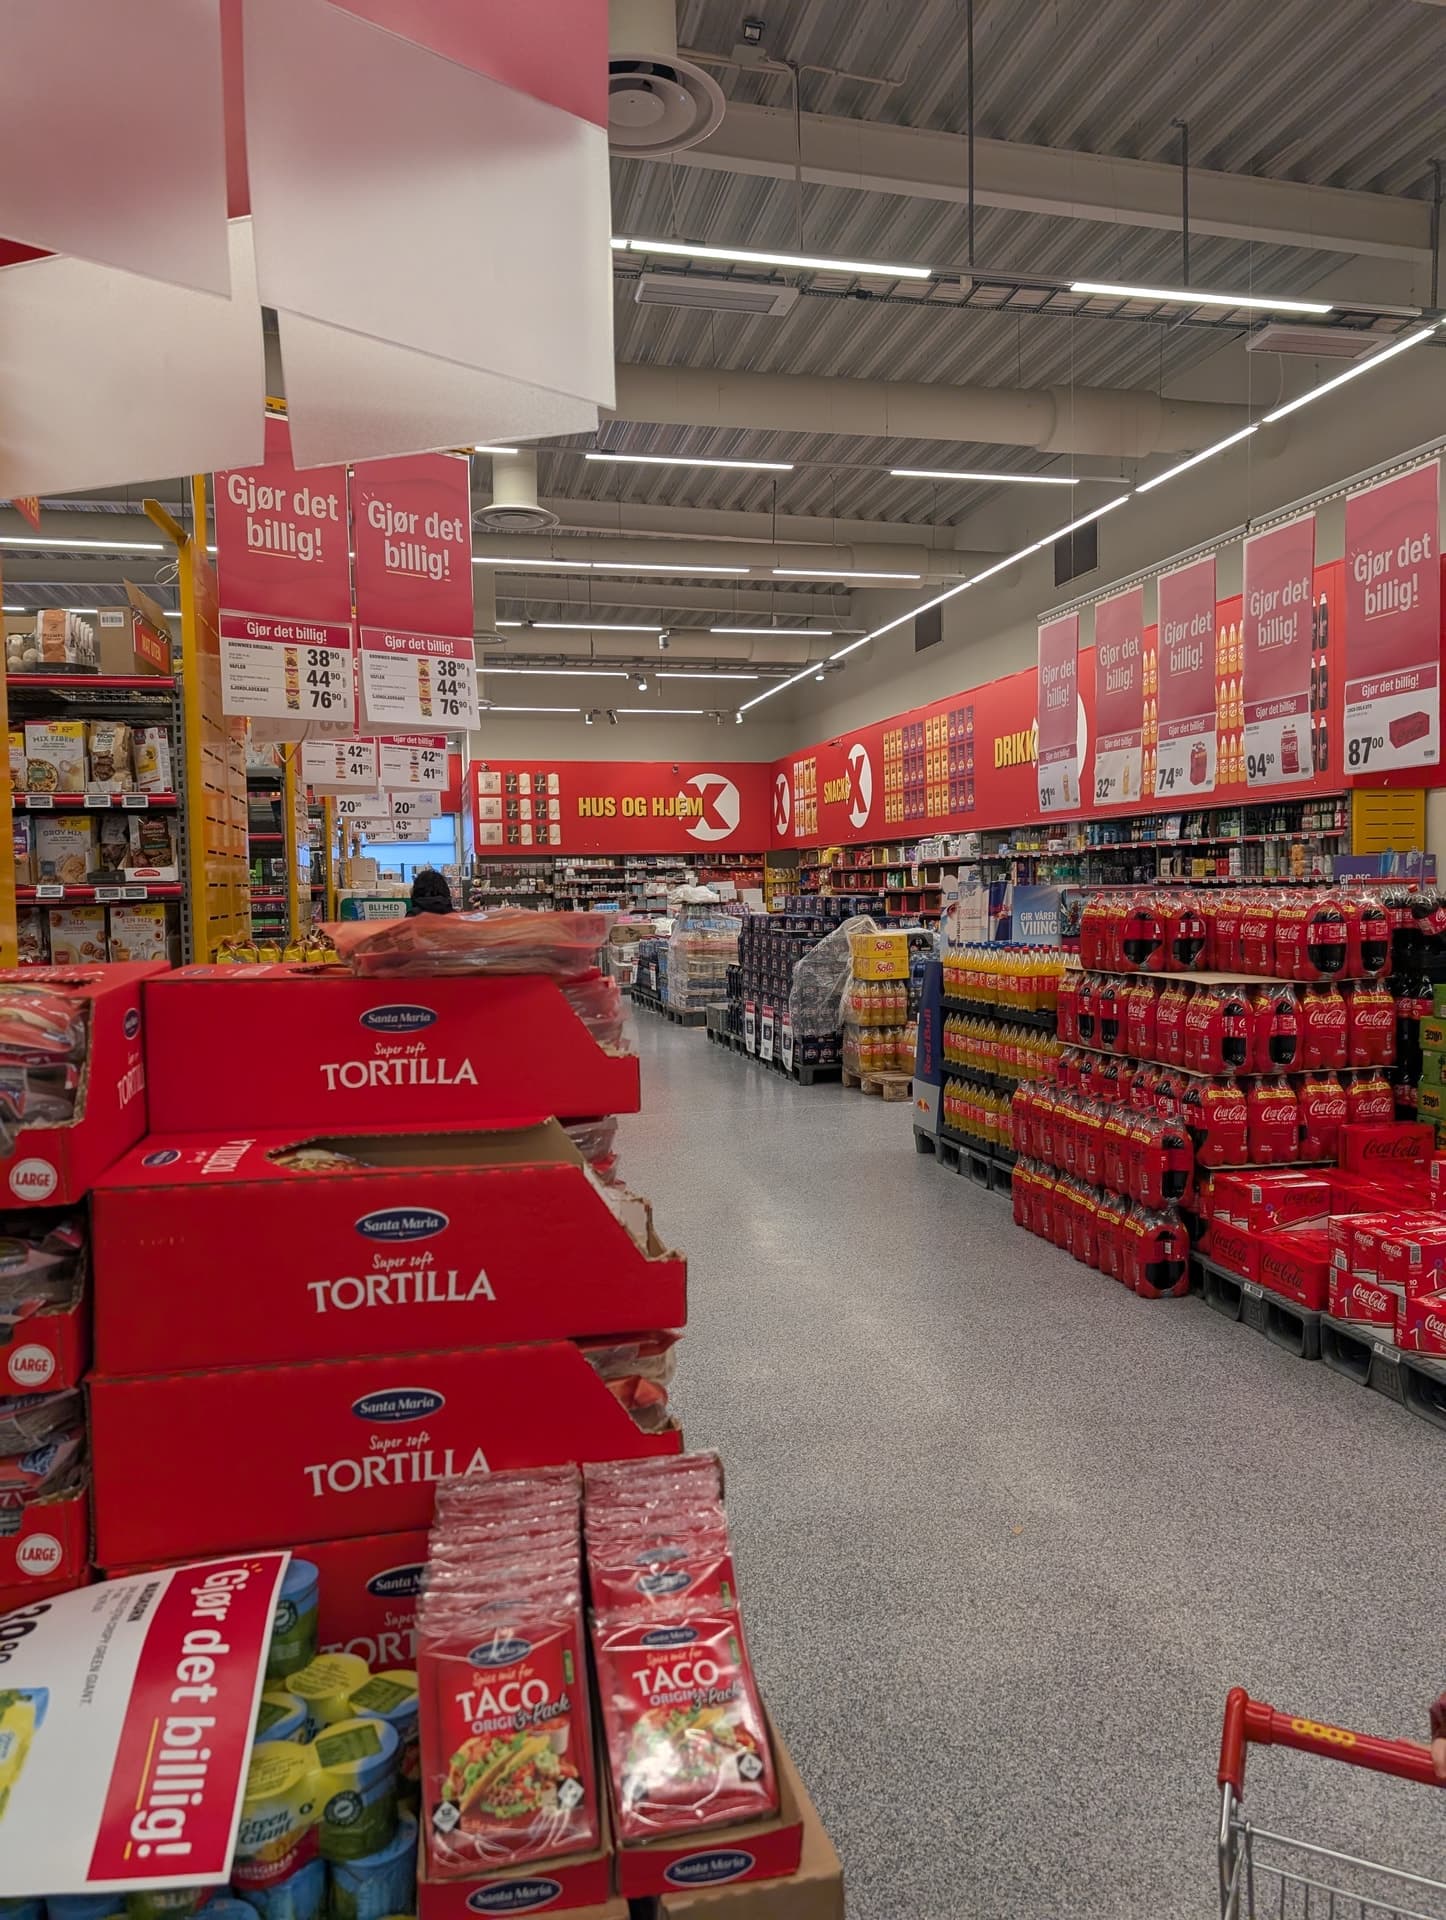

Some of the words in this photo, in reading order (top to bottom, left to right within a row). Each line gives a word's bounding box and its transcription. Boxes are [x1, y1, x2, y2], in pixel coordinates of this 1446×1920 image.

[228, 474, 286, 513] Gjør
[293, 487, 338, 521] det
[368, 500, 418, 536] Gjør
[425, 512, 463, 543] det
[247, 517, 323, 561] billig!
[385, 540, 450, 580] billig!
[1354, 550, 1392, 585] Gjør
[1398, 533, 1432, 568] det
[1250, 590, 1280, 620] Gjør
[1283, 577, 1309, 606] det
[1365, 574, 1419, 615] billig!
[247, 622, 271, 638] Gjør
[274, 625, 293, 639] det
[296, 627, 327, 643] billig!
[1164, 622, 1188, 648] Gjør
[1191, 610, 1213, 634] det
[1258, 612, 1298, 646] billig!
[385, 635, 406, 650] Gjør
[408, 638, 426, 650] det
[427, 640, 454, 654] billig!
[1100, 643, 1119, 667] Gjør
[1122, 636, 1140, 658] det
[1170, 642, 1203, 672] billig!
[1042, 664, 1060, 685] Gjør
[1060, 657, 1075, 677] det
[1106, 664, 1133, 691] billig!
[1046, 685, 1070, 708] billig!
[1362, 683, 1379, 698] Gjør
[1380, 679, 1394, 692] det
[1395, 673, 1419, 690] billig!
[1255, 706, 1268, 719] Gjør
[1269, 703, 1278, 715] det
[1279, 700, 1297, 715] billig!
[1169, 723, 1180, 736] Gjør
[1180, 721, 1189, 732] det
[1190, 719, 1205, 732] billig!
[578, 796, 616, 816] HUS
[622, 796, 647, 816] OG
[652, 796, 704, 817] HJEM
[368, 903, 380, 911] BLI
[381, 903, 400, 911] MED
[1020, 912, 1032, 921] GIR
[1034, 910, 1057, 920] VÅREN
[368, 1013, 398, 1024] Santa
[399, 1012, 431, 1023] Maria
[374, 1042, 402, 1058] Super
[405, 1041, 427, 1057] soft
[320, 1057, 479, 1091] TORTILLA
[16, 1172, 50, 1187] LARGE
[363, 1219, 400, 1232] Santa
[401, 1217, 439, 1229] Maria
[372, 1253, 405, 1272] Super
[410, 1251, 434, 1270] soft
[307, 1268, 497, 1313] TORTILLA
[14, 1357, 49, 1372] LARGE
[360, 1402, 396, 1414] Santa
[397, 1397, 435, 1411] Maria
[369, 1434, 402, 1452] Super
[406, 1431, 431, 1450] soft
[304, 1447, 491, 1497] TORTILLA
[22, 1548, 56, 1561] LARGE
[191, 1568, 250, 1622] Gjør
[375, 1577, 411, 1590] Santa
[89, 1645, 108, 1673] GREEN
[170, 1628, 230, 1704] det
[632, 1659, 719, 1697] TACO
[456, 1679, 549, 1723] TACO
[514, 1692, 571, 1730] 3-Pack
[129, 1715, 216, 1858] billig!
[675, 1861, 707, 1877] Santa
[708, 1855, 746, 1872] Maria
[476, 1889, 514, 1905] Santa
[515, 1884, 553, 1900] Maria
